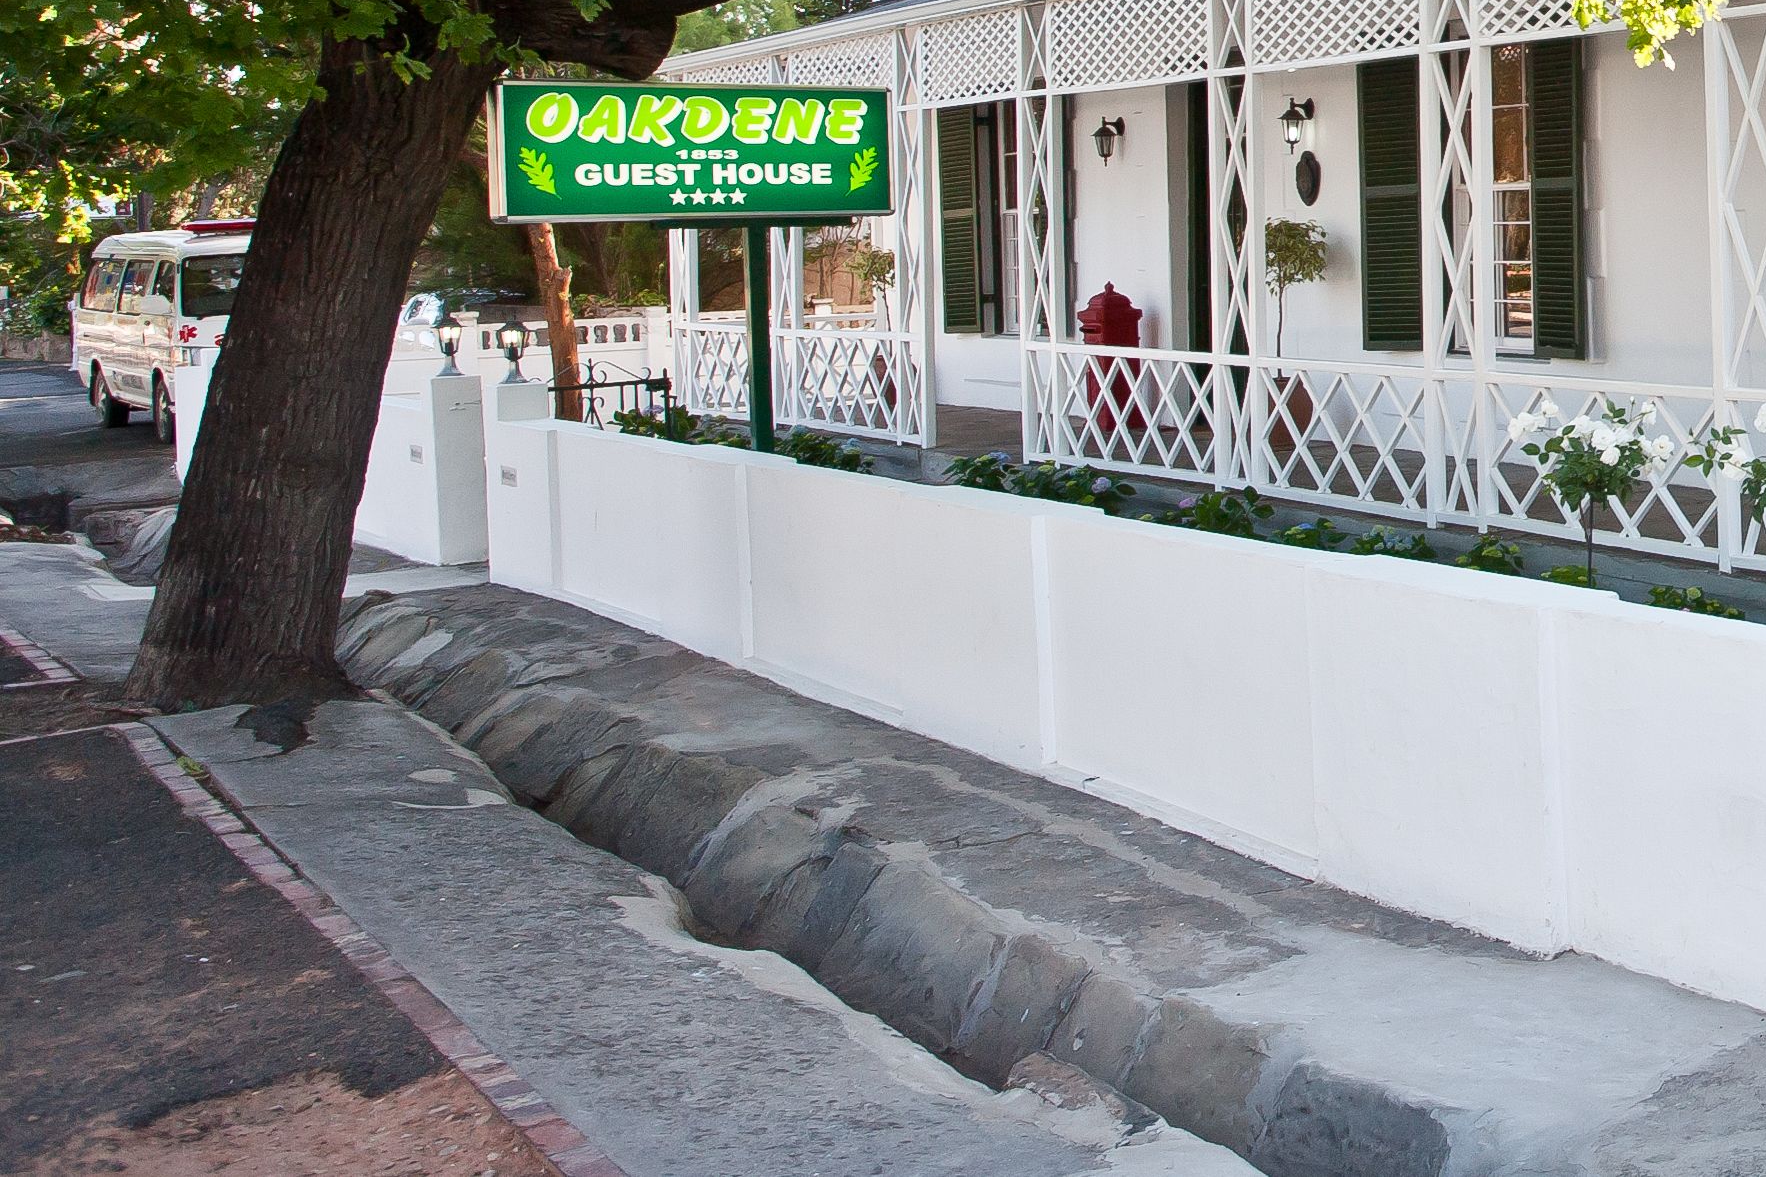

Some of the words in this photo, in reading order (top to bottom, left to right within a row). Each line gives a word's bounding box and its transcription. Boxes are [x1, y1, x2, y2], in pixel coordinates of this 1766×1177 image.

[527, 92, 868, 147] OAKDENE
[675, 149, 740, 160] 1853
[575, 163, 701, 186] GUEST
[713, 163, 832, 185] HOUSE
